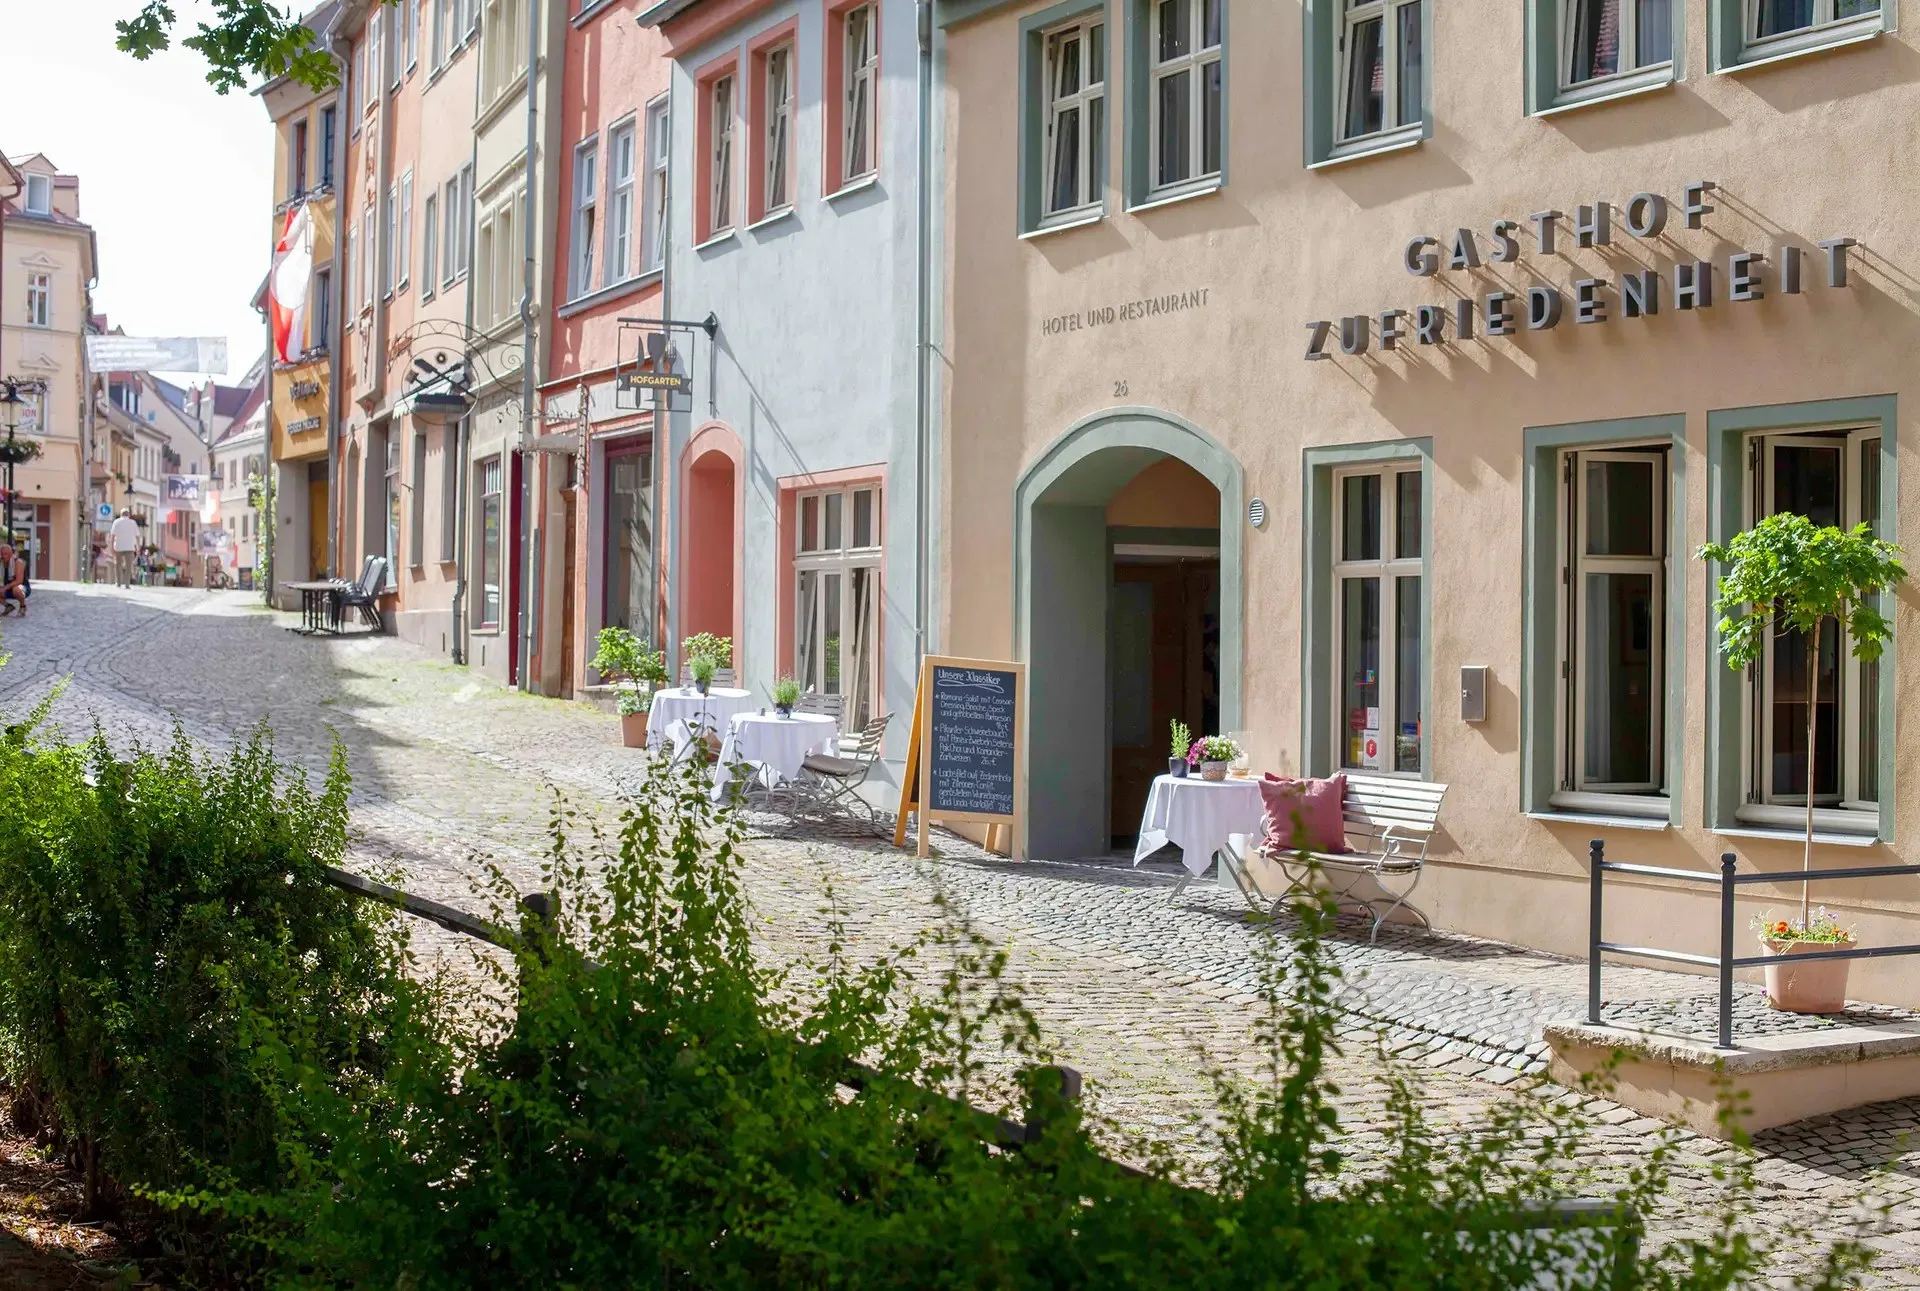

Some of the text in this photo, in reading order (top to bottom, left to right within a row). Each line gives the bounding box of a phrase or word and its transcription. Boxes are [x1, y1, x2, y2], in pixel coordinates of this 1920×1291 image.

[1404, 180, 1716, 277] GASTHOF
[1304, 237, 1857, 361] ZUFRIEDENHEIT
[1042, 288, 1209, 336] HOTEL UND RESTAURANT
[630, 375, 681, 386] HOFGARTEN
[1113, 379, 1129, 397] 26
[938, 669, 1001, 685] Unsere Klassiker
[939, 734, 950, 742] mit
[962, 746, 975, 754] und
[939, 798, 952, 806] und
